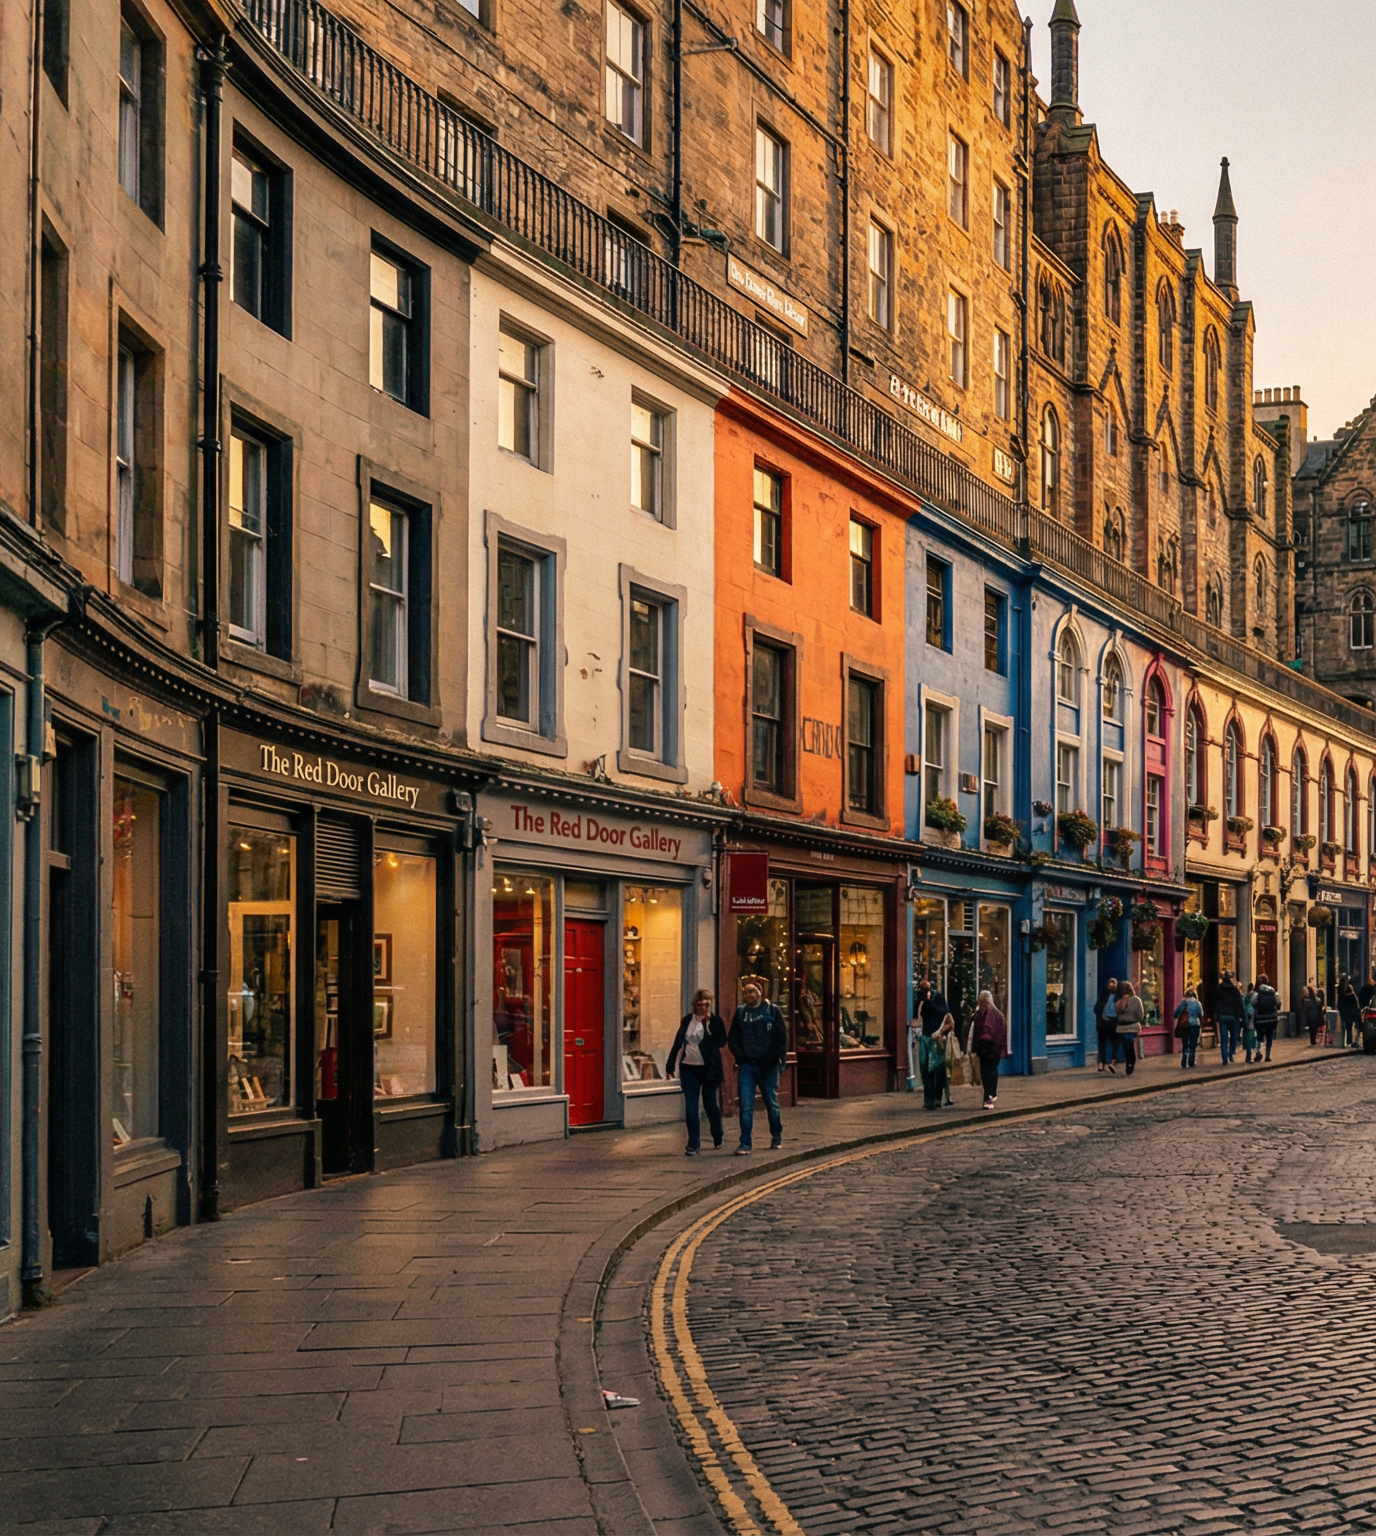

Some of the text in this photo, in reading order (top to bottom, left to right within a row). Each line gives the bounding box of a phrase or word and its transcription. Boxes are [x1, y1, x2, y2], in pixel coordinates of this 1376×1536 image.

[260, 744, 420, 810] The Red Door Gallery
[510, 804, 682, 861] The Red Door Gallery
